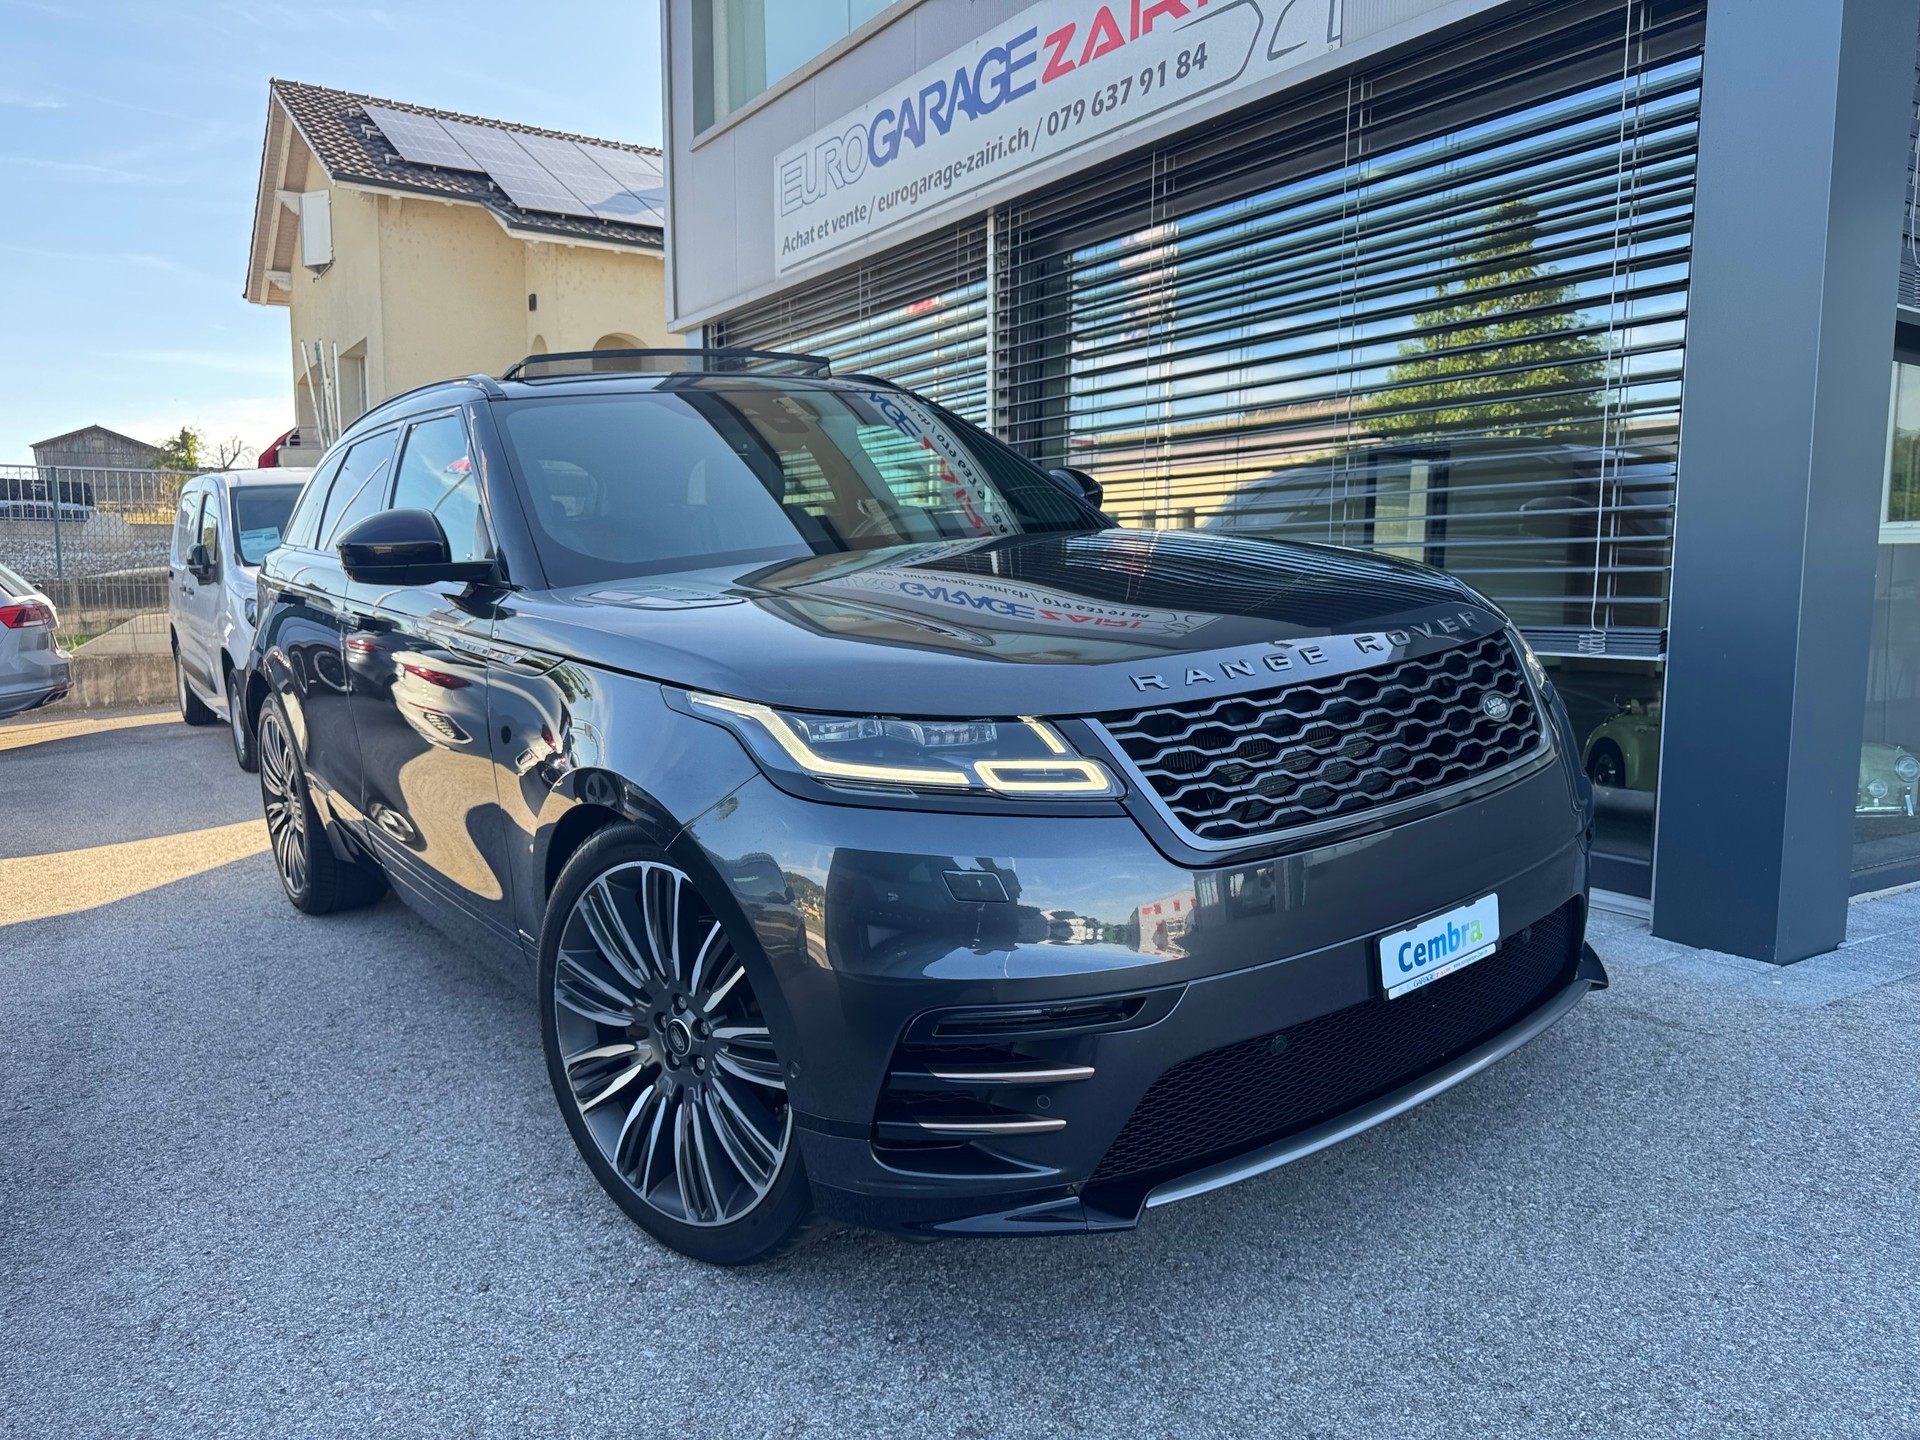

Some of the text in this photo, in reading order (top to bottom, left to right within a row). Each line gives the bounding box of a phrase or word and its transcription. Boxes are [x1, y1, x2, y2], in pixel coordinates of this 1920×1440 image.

[782, 227, 815, 256] Achat
[817, 219, 829, 239] et
[832, 205, 867, 233] vente
[878, 127, 1029, 213] eurogarage-zairi.ch
[1047, 98, 1085, 136] 079
[1091, 76, 1133, 117] 637
[1139, 60, 1166, 96] 91
[1176, 42, 1208, 79] 84
[1129, 611, 1479, 691] RANGE ROVER
[1398, 919, 1483, 973] Cembra
